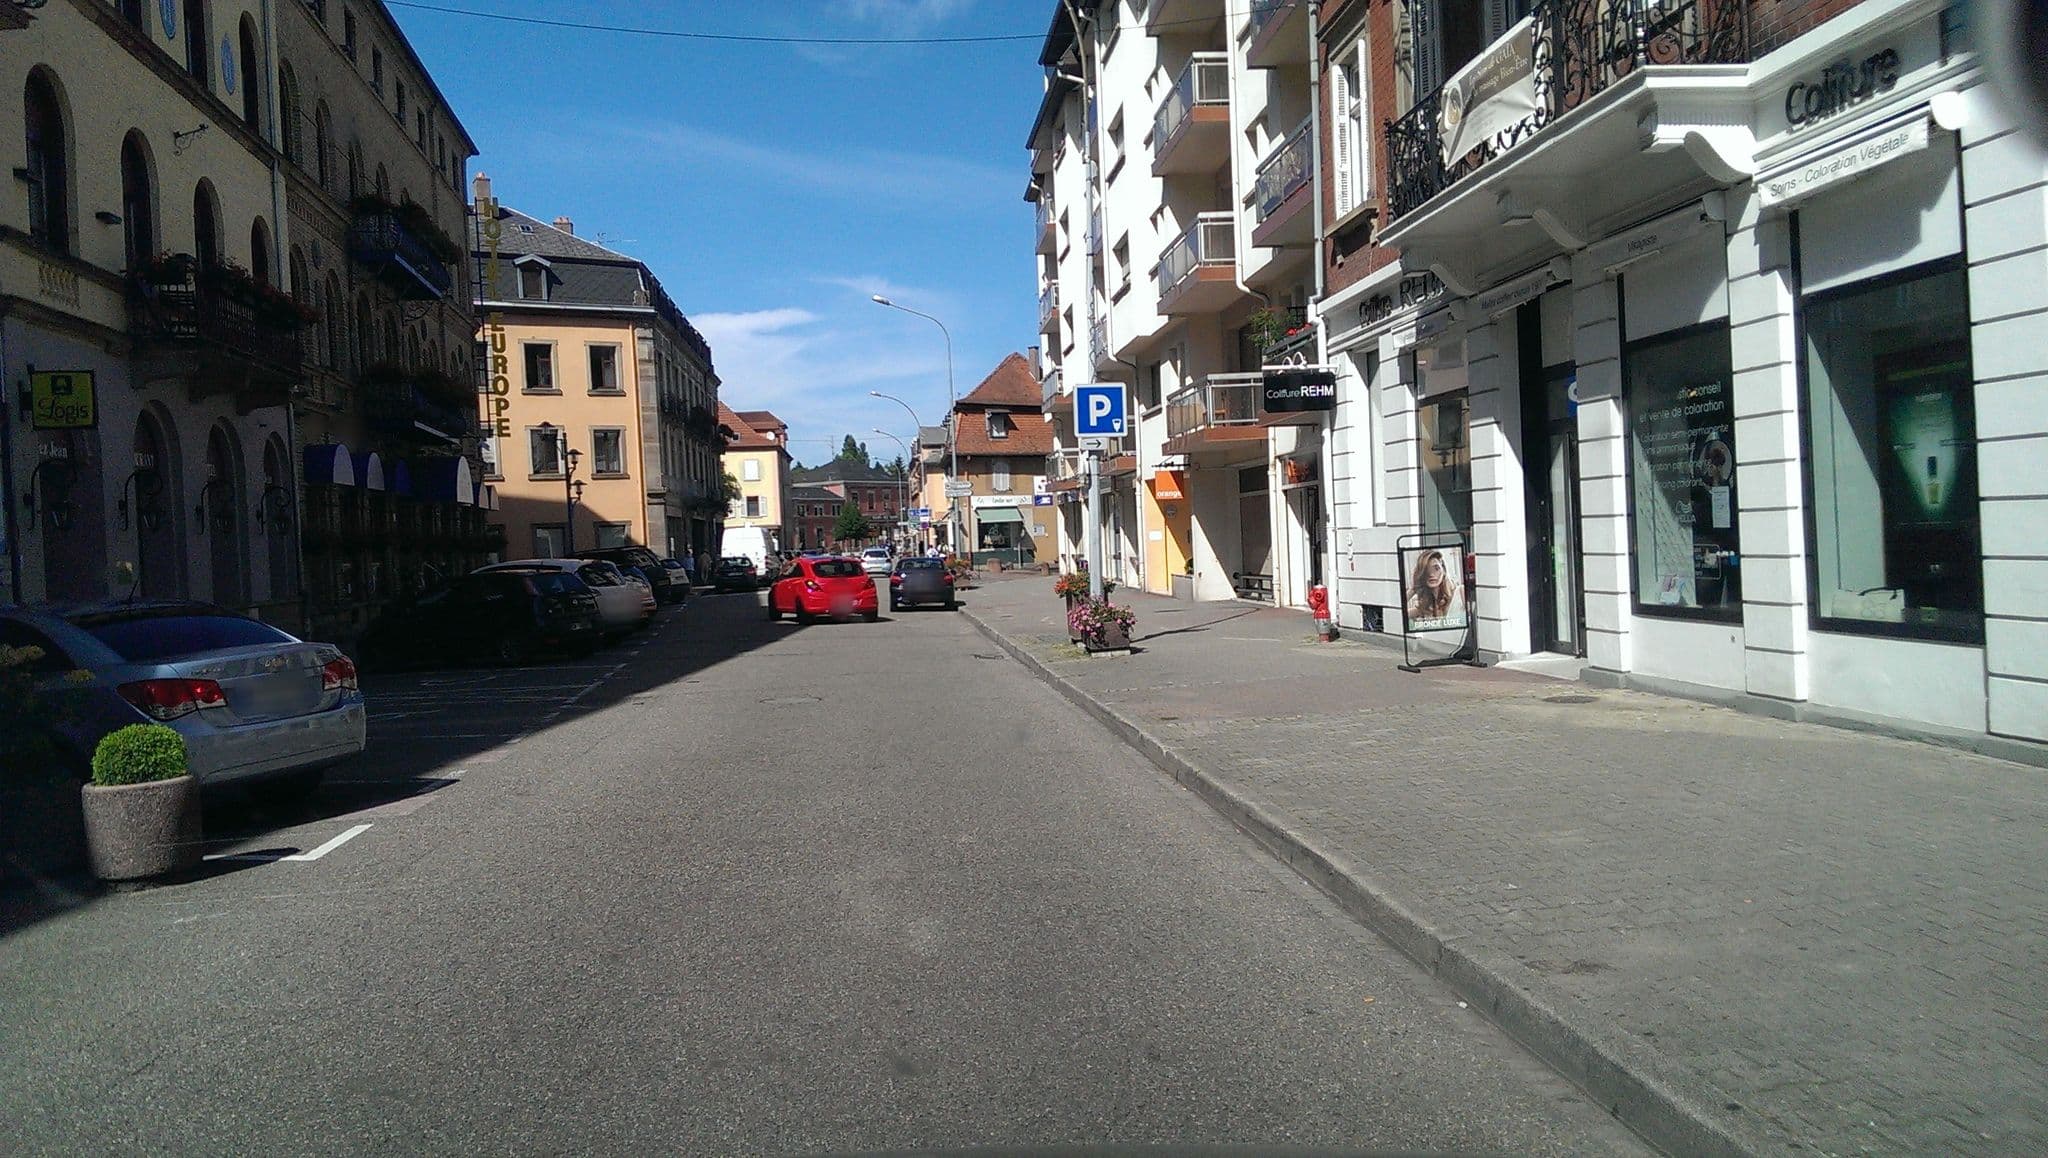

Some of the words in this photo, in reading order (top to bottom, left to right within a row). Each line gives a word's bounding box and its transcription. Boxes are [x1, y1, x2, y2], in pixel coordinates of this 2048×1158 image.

[1785, 47, 1900, 127] Coiffure
[1770, 178, 1797, 197] Soins
[1804, 154, 1858, 184] Coloration
[1858, 131, 1909, 162] Végétale
[490, 312, 512, 438] EUROPE
[1088, 394, 1112, 427] P
[1649, 407, 1670, 420] vente
[1671, 405, 1682, 418] de
[1684, 399, 1725, 416] coloration
